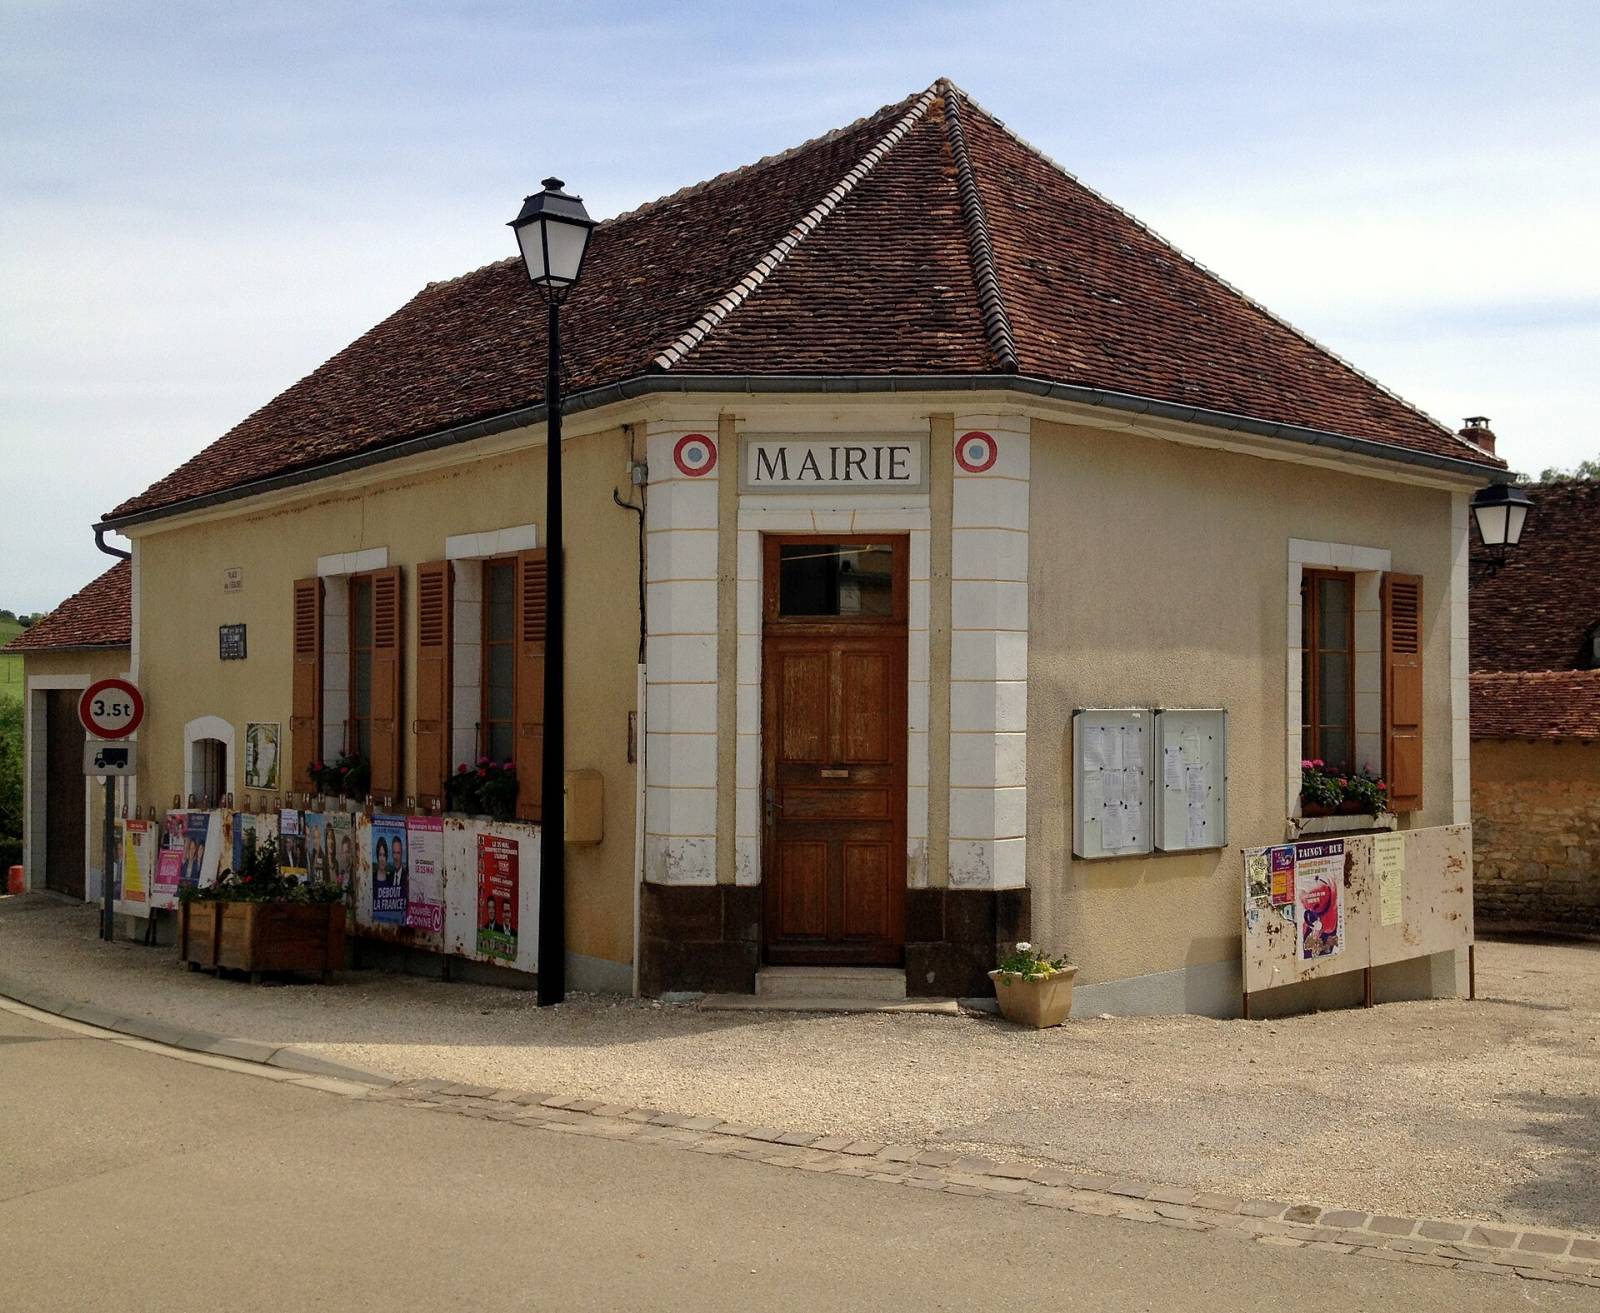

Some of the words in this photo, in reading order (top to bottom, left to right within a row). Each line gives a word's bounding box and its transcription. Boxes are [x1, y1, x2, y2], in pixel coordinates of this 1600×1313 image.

[754, 446, 911, 481] MAIRIE
[94, 701, 130, 717] 3.5t
[407, 797, 415, 808] 19
[1299, 847, 1323, 859] TAINGY
[378, 886, 402, 898] DEBOUT
[373, 899, 382, 911] LA
